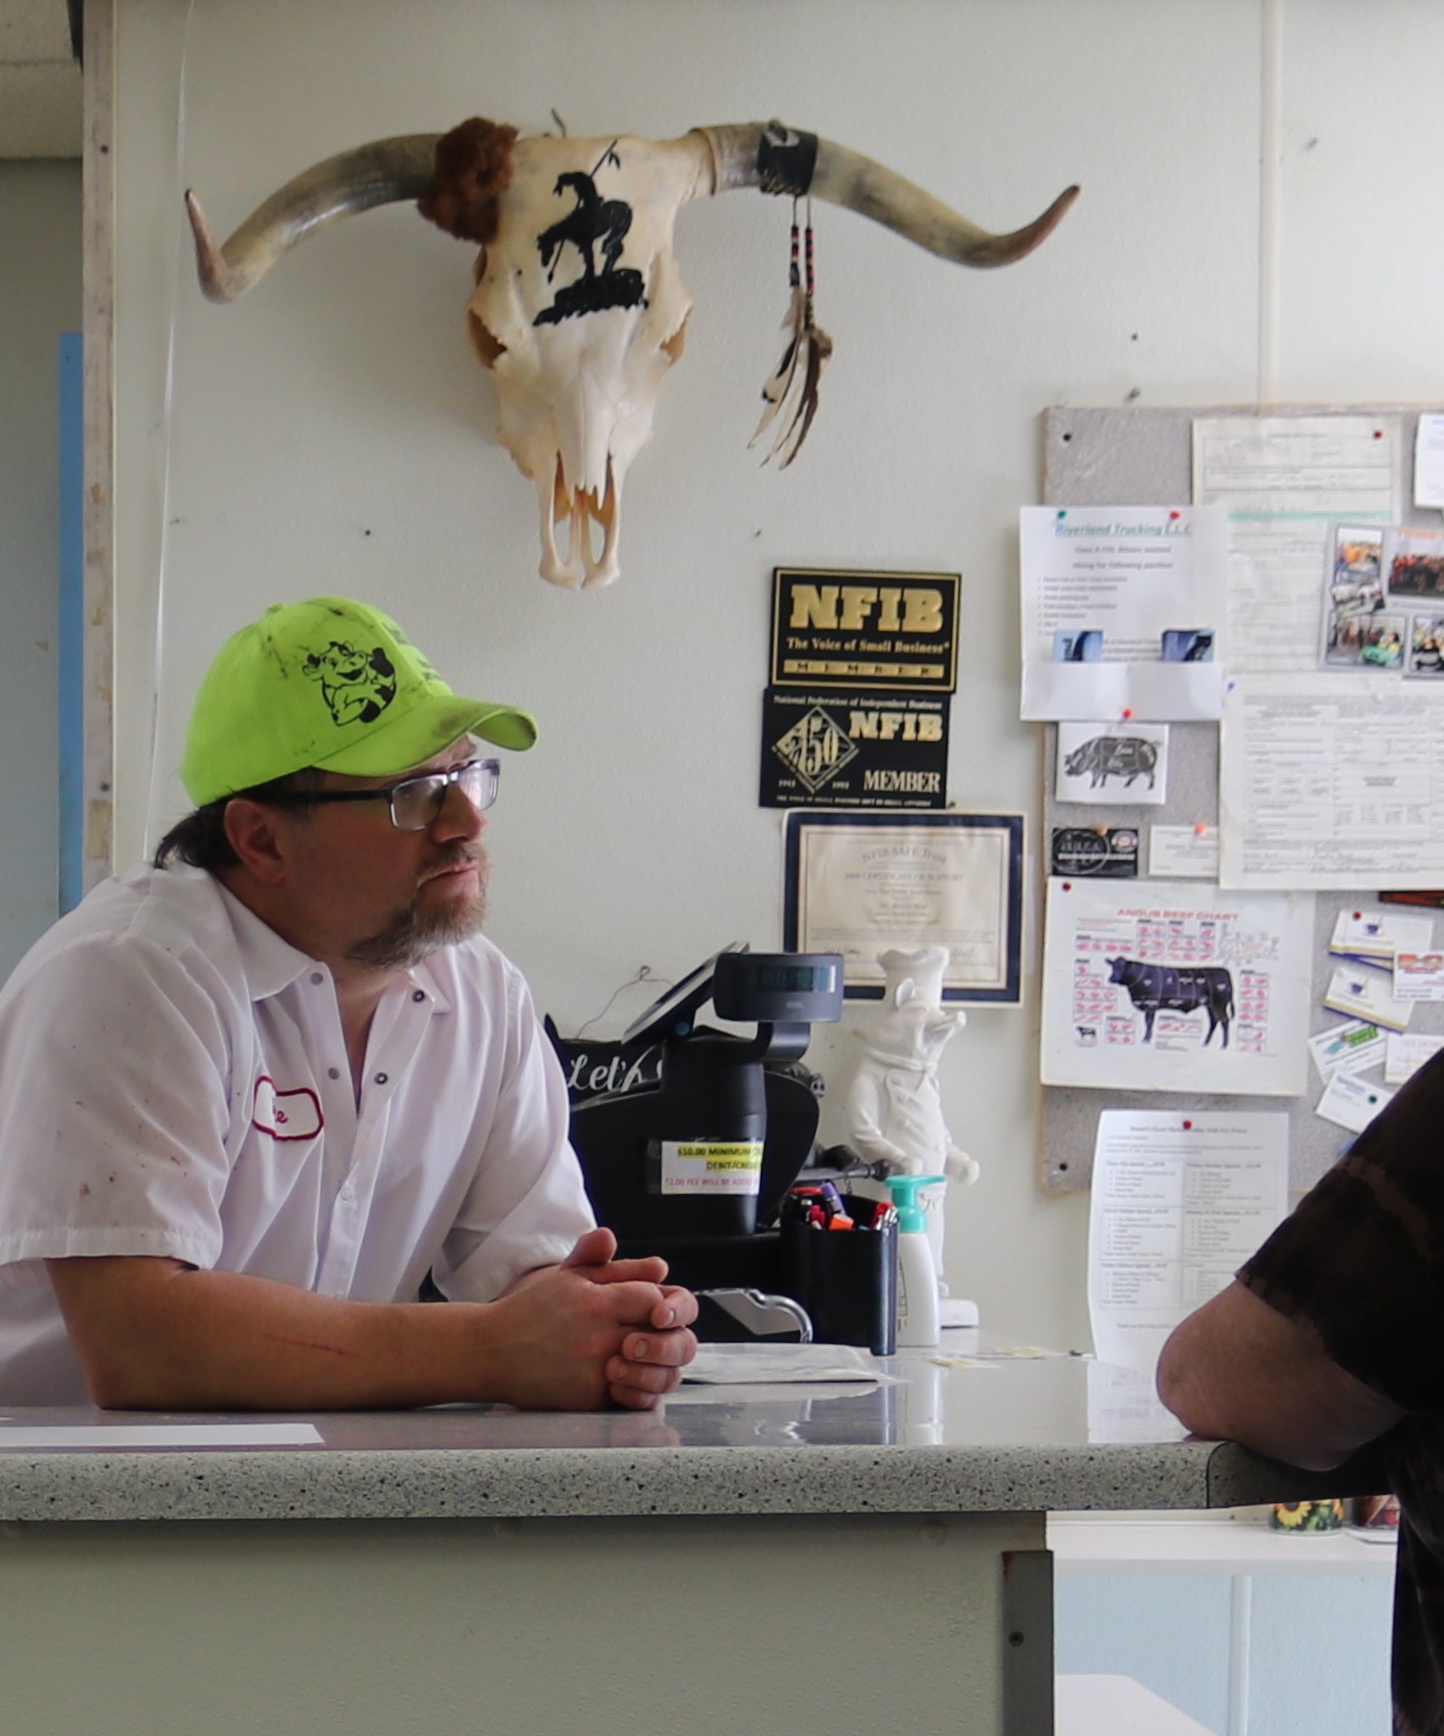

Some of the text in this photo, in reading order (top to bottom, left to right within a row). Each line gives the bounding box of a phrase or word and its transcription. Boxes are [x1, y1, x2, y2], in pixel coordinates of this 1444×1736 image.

[1054, 523, 1162, 537] Riverland Trucking
[790, 584, 944, 634] NFIB
[787, 636, 809, 651] The
[812, 637, 842, 652] Voice
[844, 637, 858, 653] of
[860, 639, 891, 654] Small
[848, 711, 943, 742] NFIB
[863, 769, 941, 793] MEMBER
[1116, 908, 1239, 921] ANGUS BEEF CHART
[708, 1147, 751, 1156] MINIMUM
